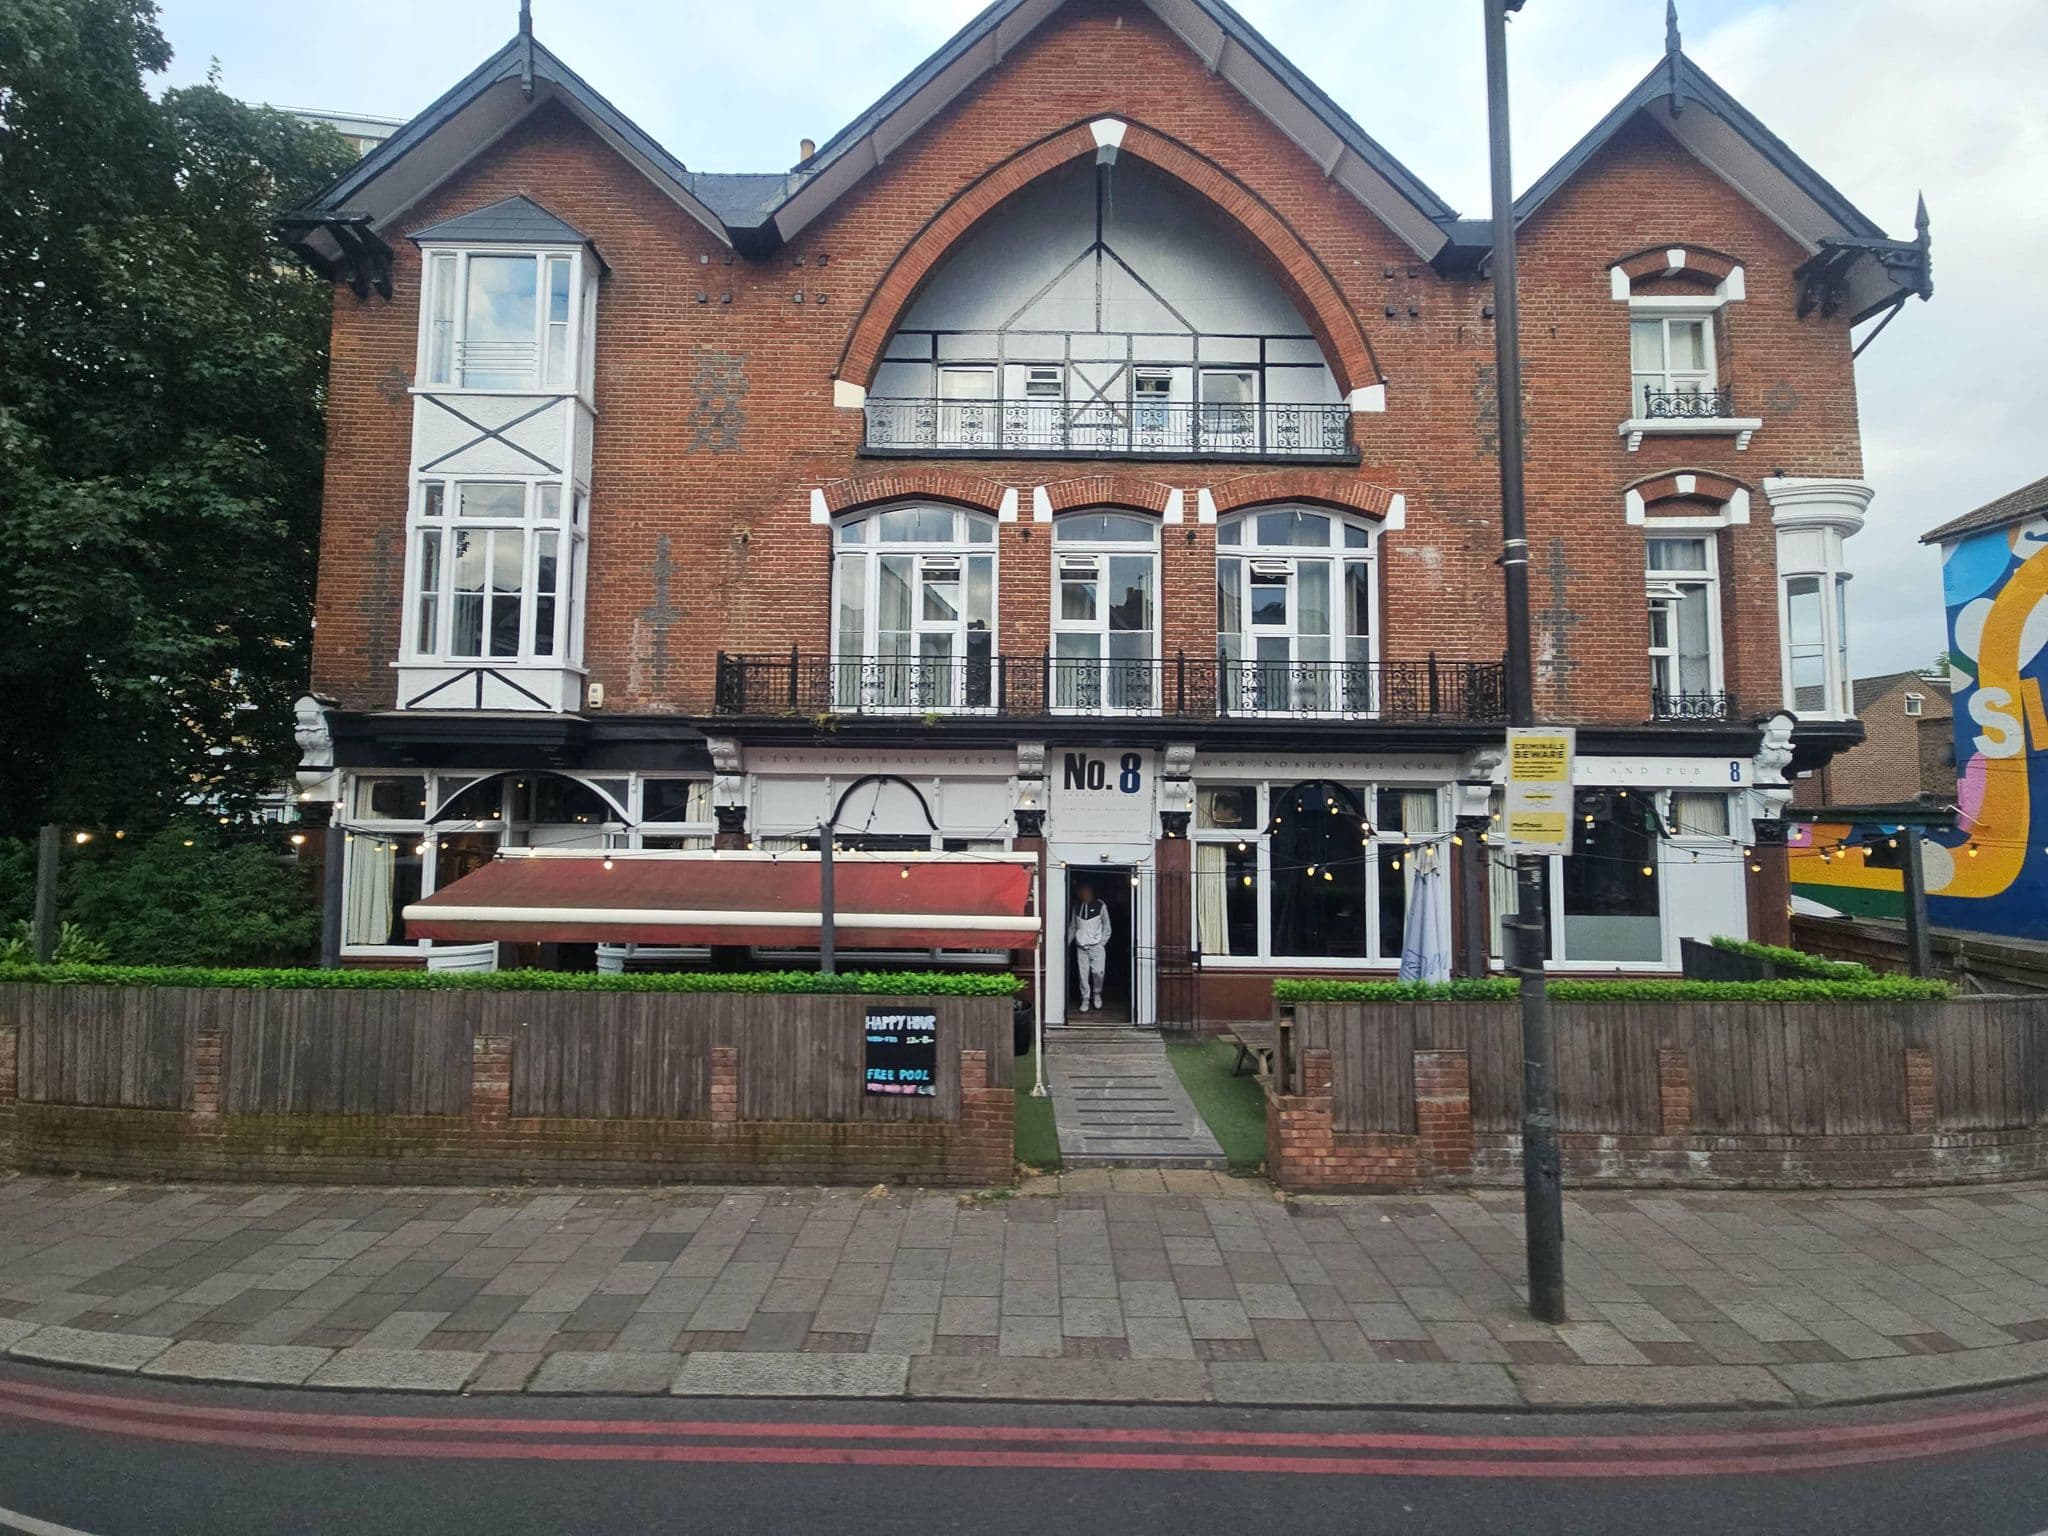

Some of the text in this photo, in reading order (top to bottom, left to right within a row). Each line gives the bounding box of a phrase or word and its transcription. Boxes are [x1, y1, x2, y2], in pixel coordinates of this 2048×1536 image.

[823, 755, 931, 764] FOOTBALL
[947, 756, 1000, 765] HERE
[1063, 752, 1142, 794] No. 8
[1609, 761, 1741, 782] AND PUB 8
[865, 1015, 936, 1030] HAPPY HOUR
[866, 1068, 930, 1080] FREE POOL
